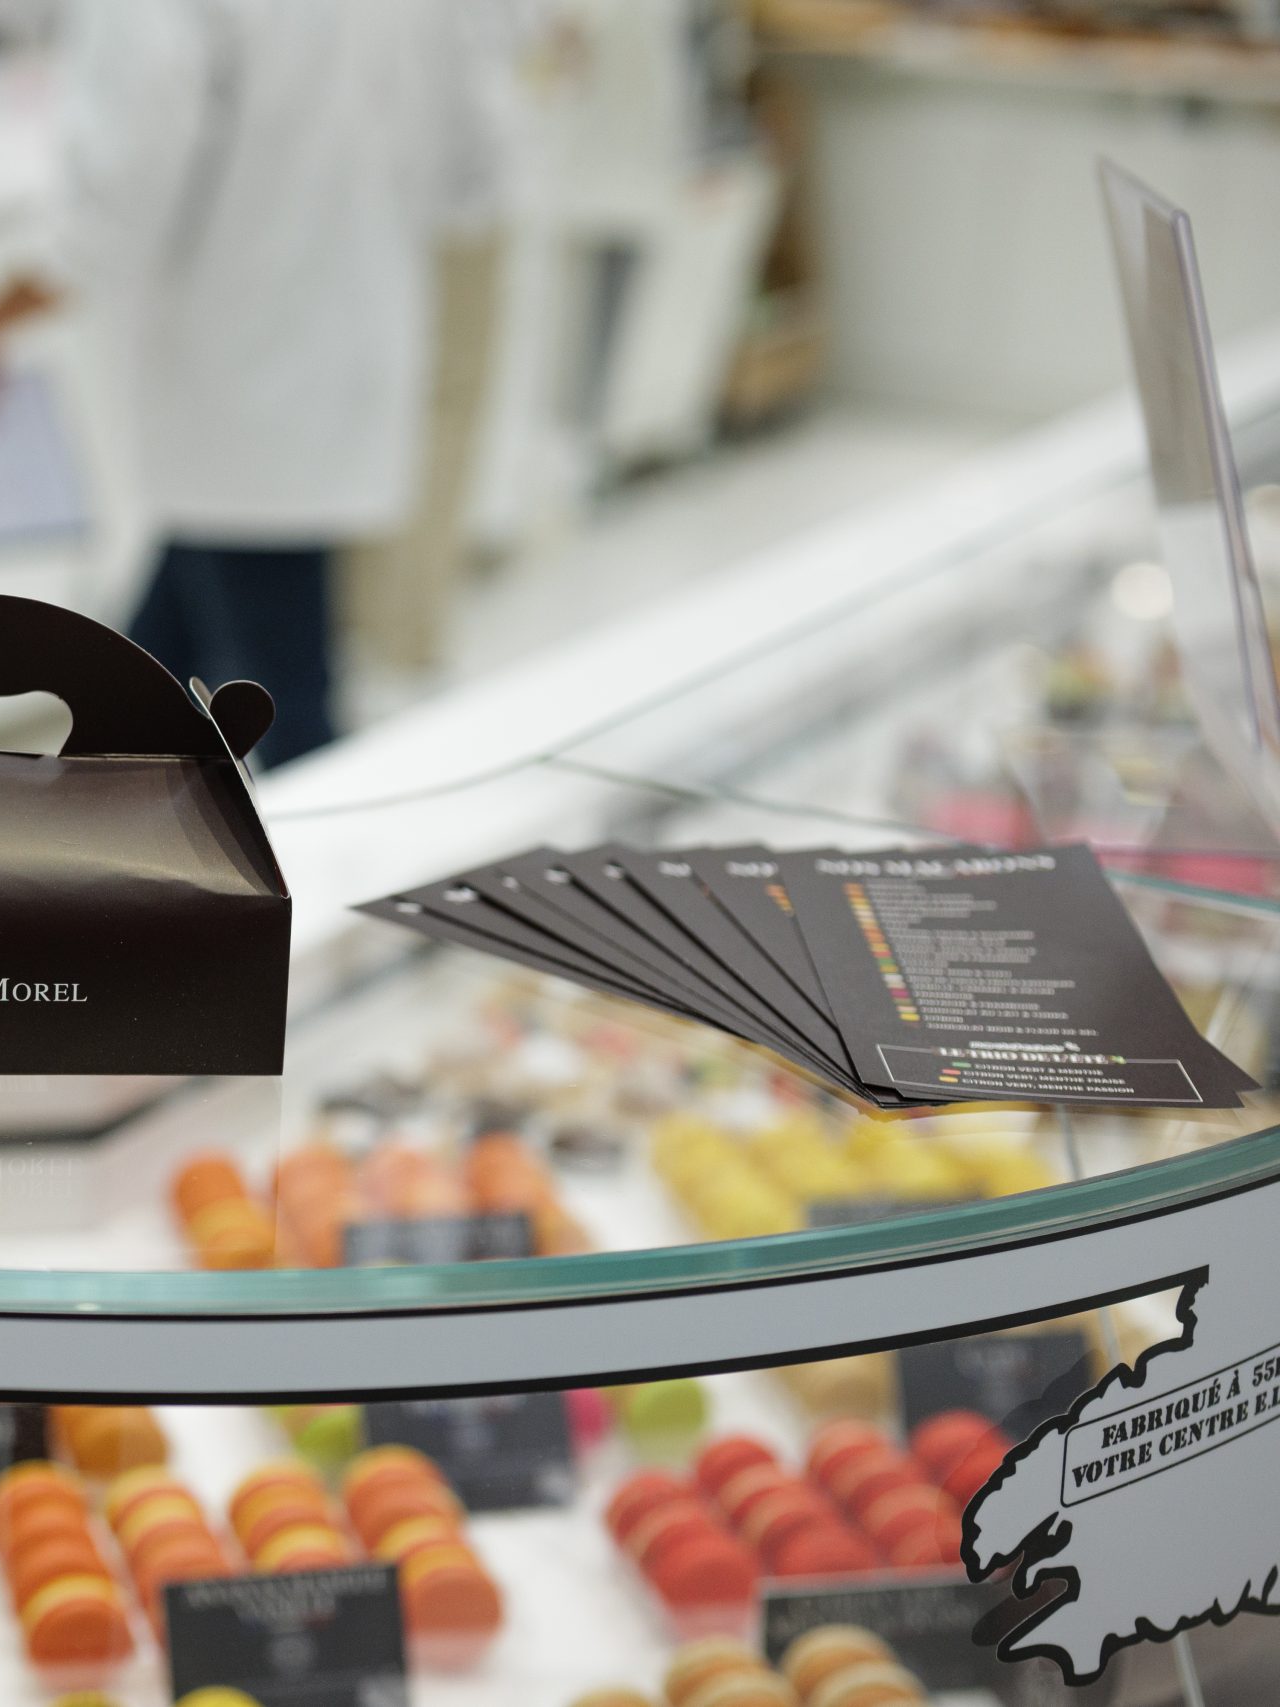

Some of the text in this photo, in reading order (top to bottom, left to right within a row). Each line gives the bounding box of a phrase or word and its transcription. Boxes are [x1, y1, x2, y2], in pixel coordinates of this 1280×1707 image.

[963, 1070, 1004, 1079] CITRON
[1039, 1075, 1084, 1083] MENTHE
[974, 1063, 1016, 1072] CITRON
[1020, 1065, 1045, 1073] VERT
[1058, 1068, 1103, 1076] MENTHE
[962, 1078, 1003, 1087] CITRON
[1038, 1083, 1084, 1092] MENTHE
[1086, 1086, 1135, 1094] PASSION
[1101, 1377, 1221, 1449] FABRIQUÉ
[1072, 1441, 1152, 1488] VOTRE
[1159, 1400, 1249, 1457] CENTRE
